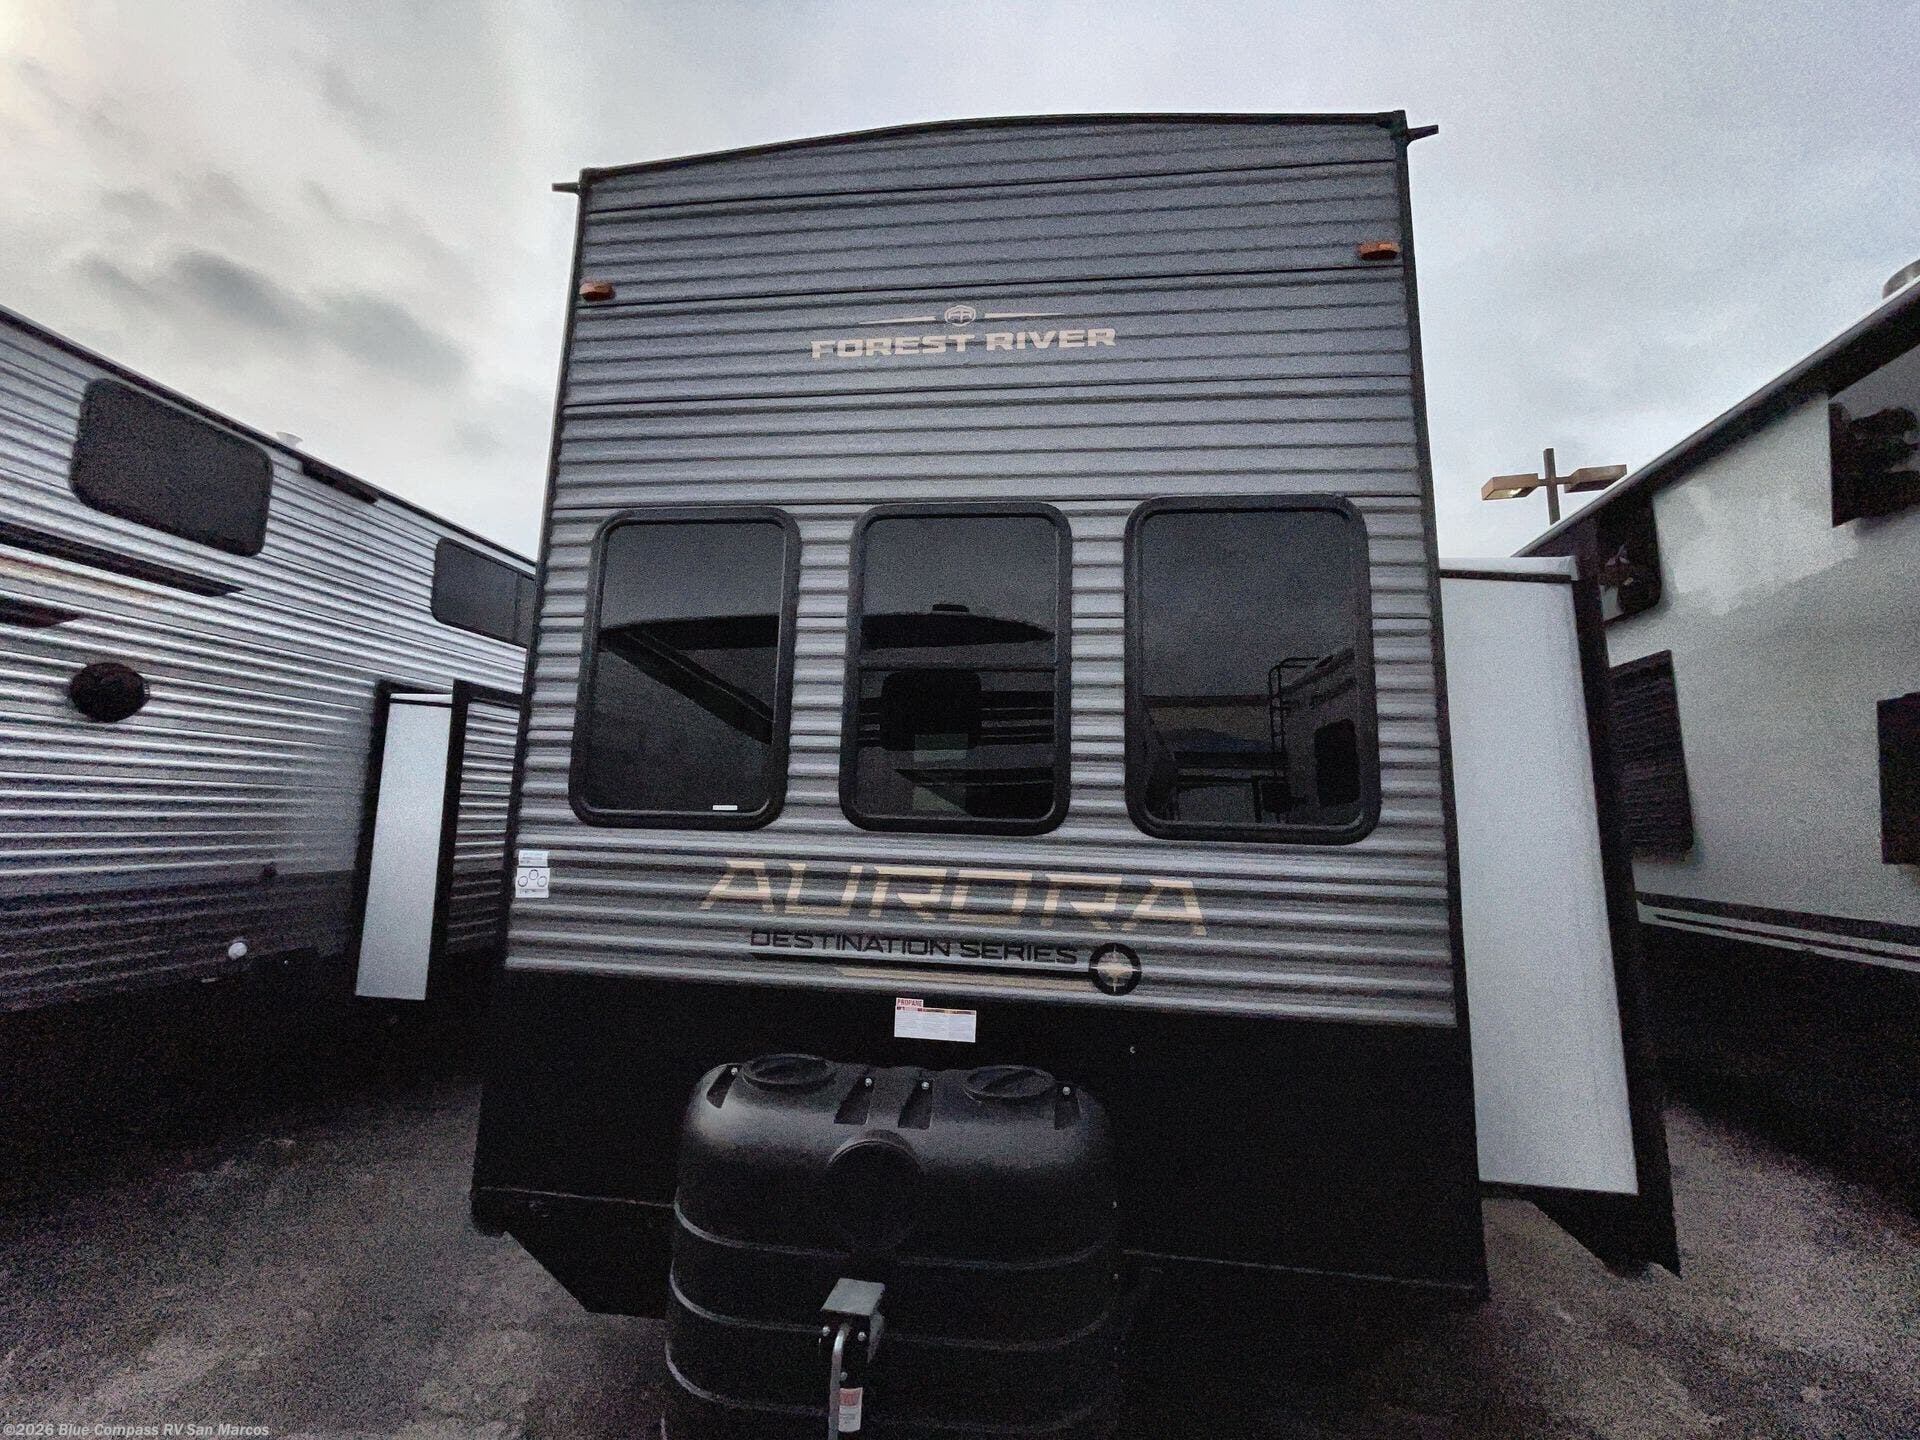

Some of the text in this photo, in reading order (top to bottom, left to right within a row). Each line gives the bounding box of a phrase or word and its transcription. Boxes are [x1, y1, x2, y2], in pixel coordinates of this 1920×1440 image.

[811, 328, 1116, 359] FOREST RIVER
[700, 859, 1207, 936] AURORA
[750, 930, 1078, 965] DESTINATION SERIES
[897, 999, 922, 1007] PROPANE
